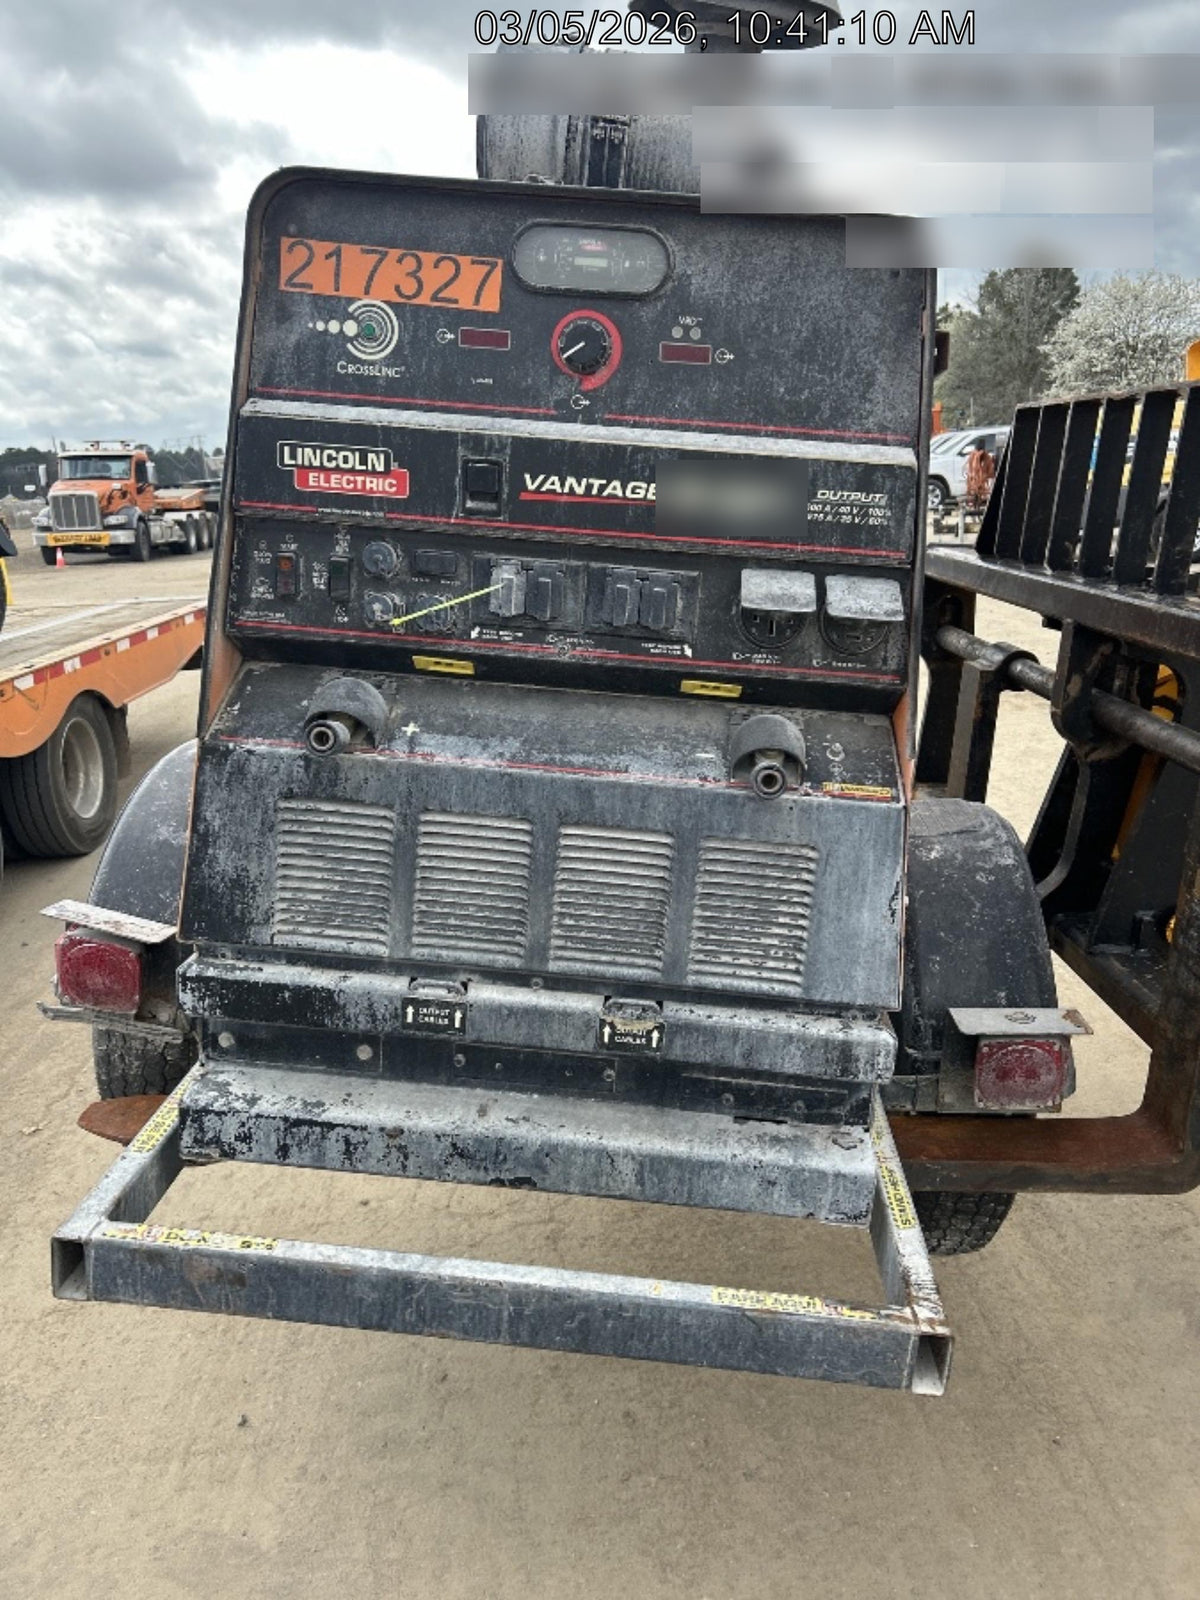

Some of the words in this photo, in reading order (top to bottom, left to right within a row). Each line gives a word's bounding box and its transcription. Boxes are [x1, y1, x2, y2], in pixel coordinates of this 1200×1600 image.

[284, 239, 499, 306] 217327
[283, 446, 385, 472] LINCOLN
[308, 472, 398, 493] ELECTRIC
[816, 489, 885, 503] OUTPUT
